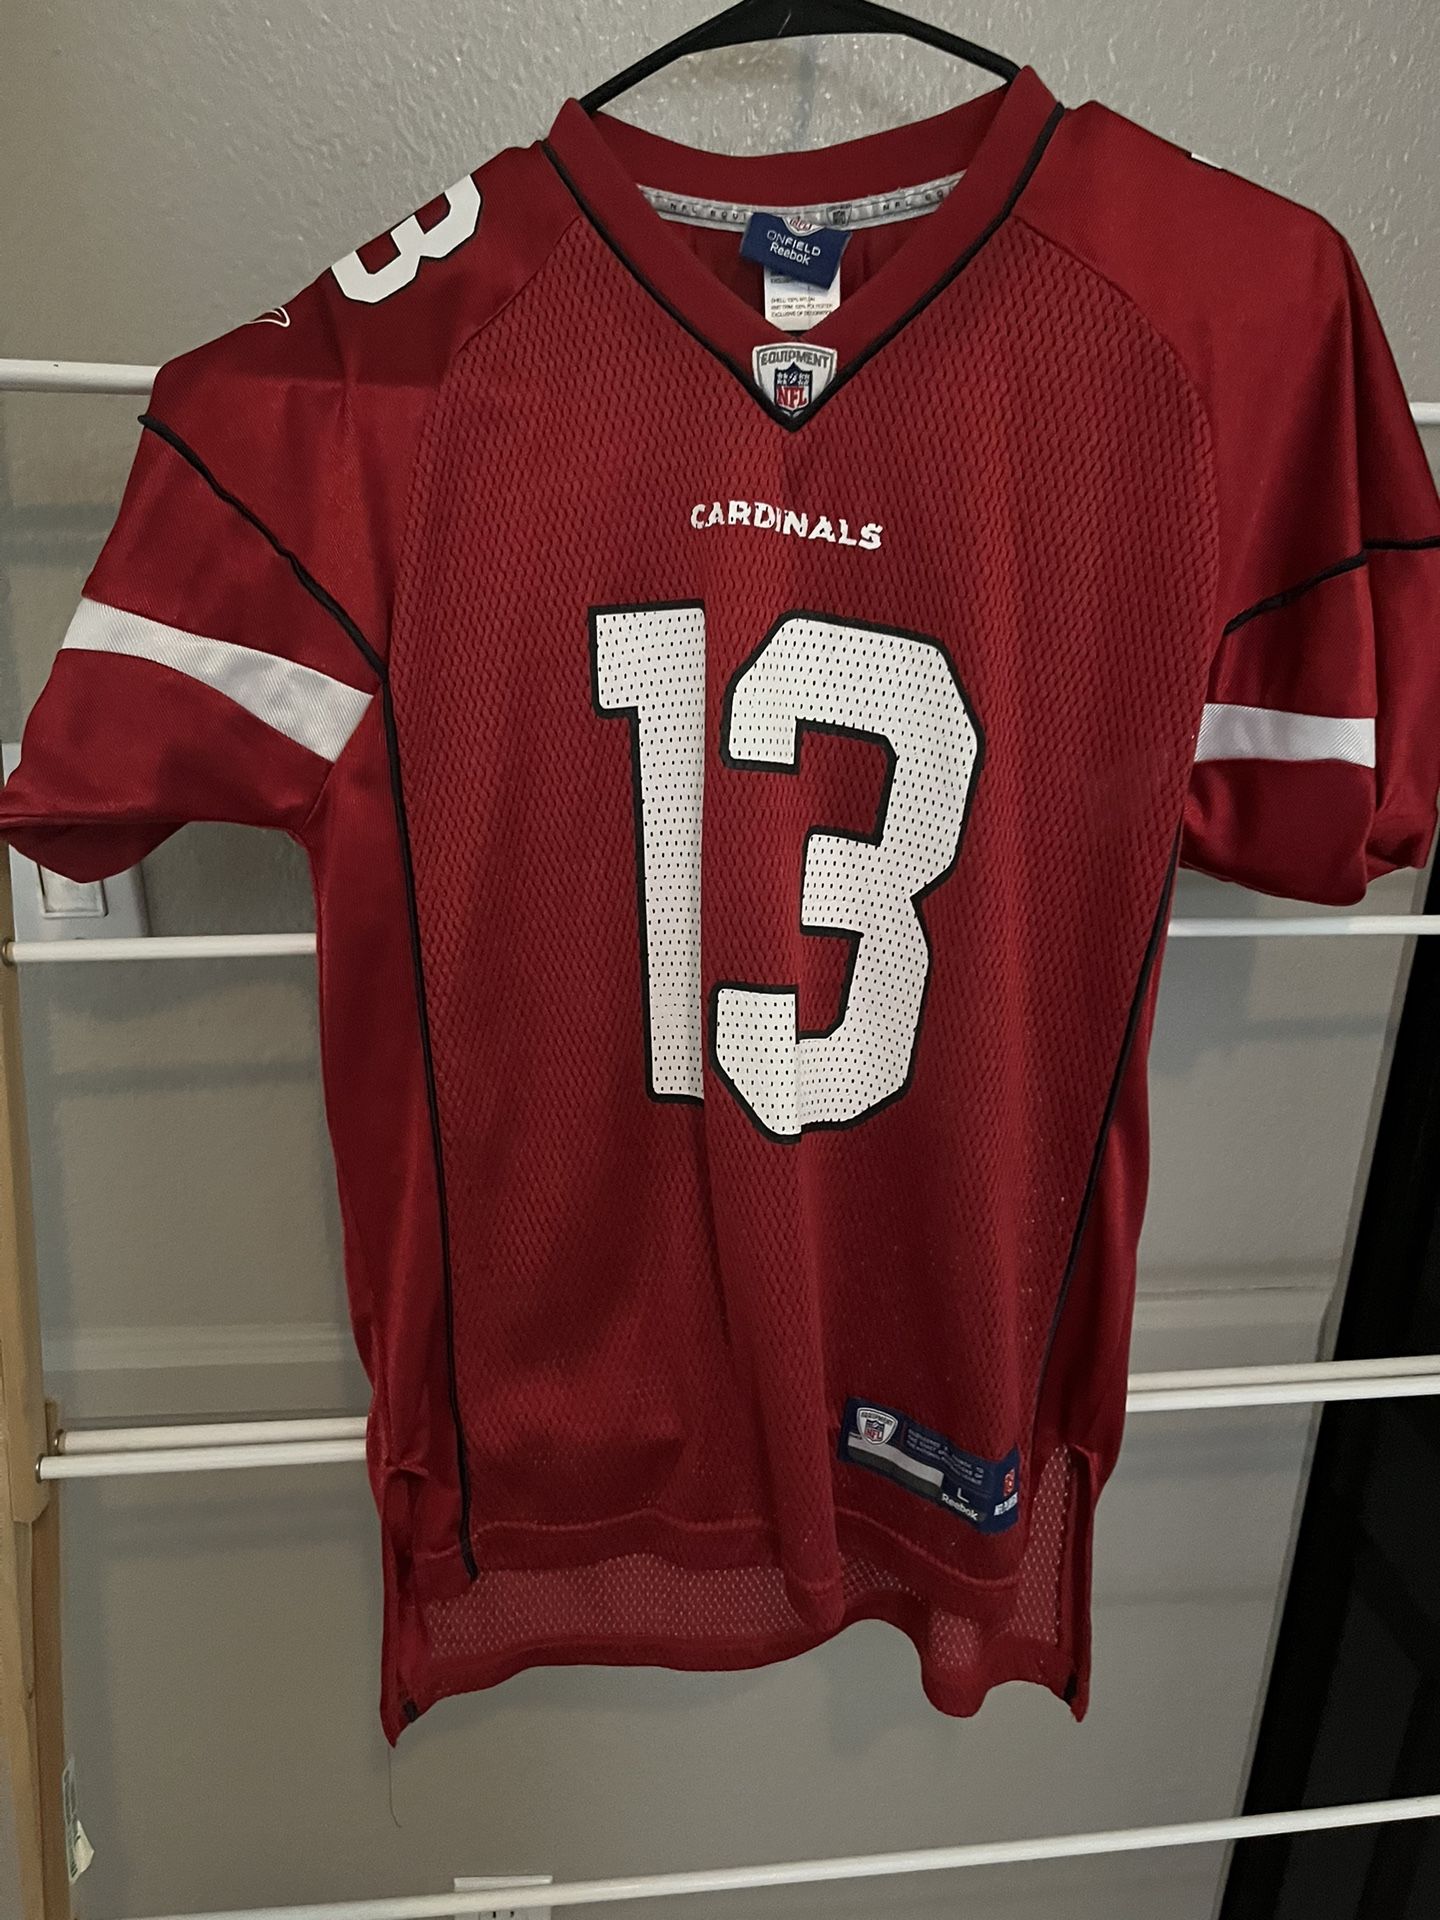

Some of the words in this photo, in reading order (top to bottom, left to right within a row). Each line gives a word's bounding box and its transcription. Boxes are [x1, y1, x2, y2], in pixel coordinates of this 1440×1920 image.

[766, 229, 821, 257] ONFIELD
[769, 241, 811, 266] Reebok
[761, 350, 830, 368] EQUIPMENT
[777, 386, 808, 408] NFL
[691, 500, 883, 550] CARDINALS
[589, 600, 982, 1140] 13
[942, 1493, 978, 1520] Reebok
[957, 1488, 970, 1503] L
